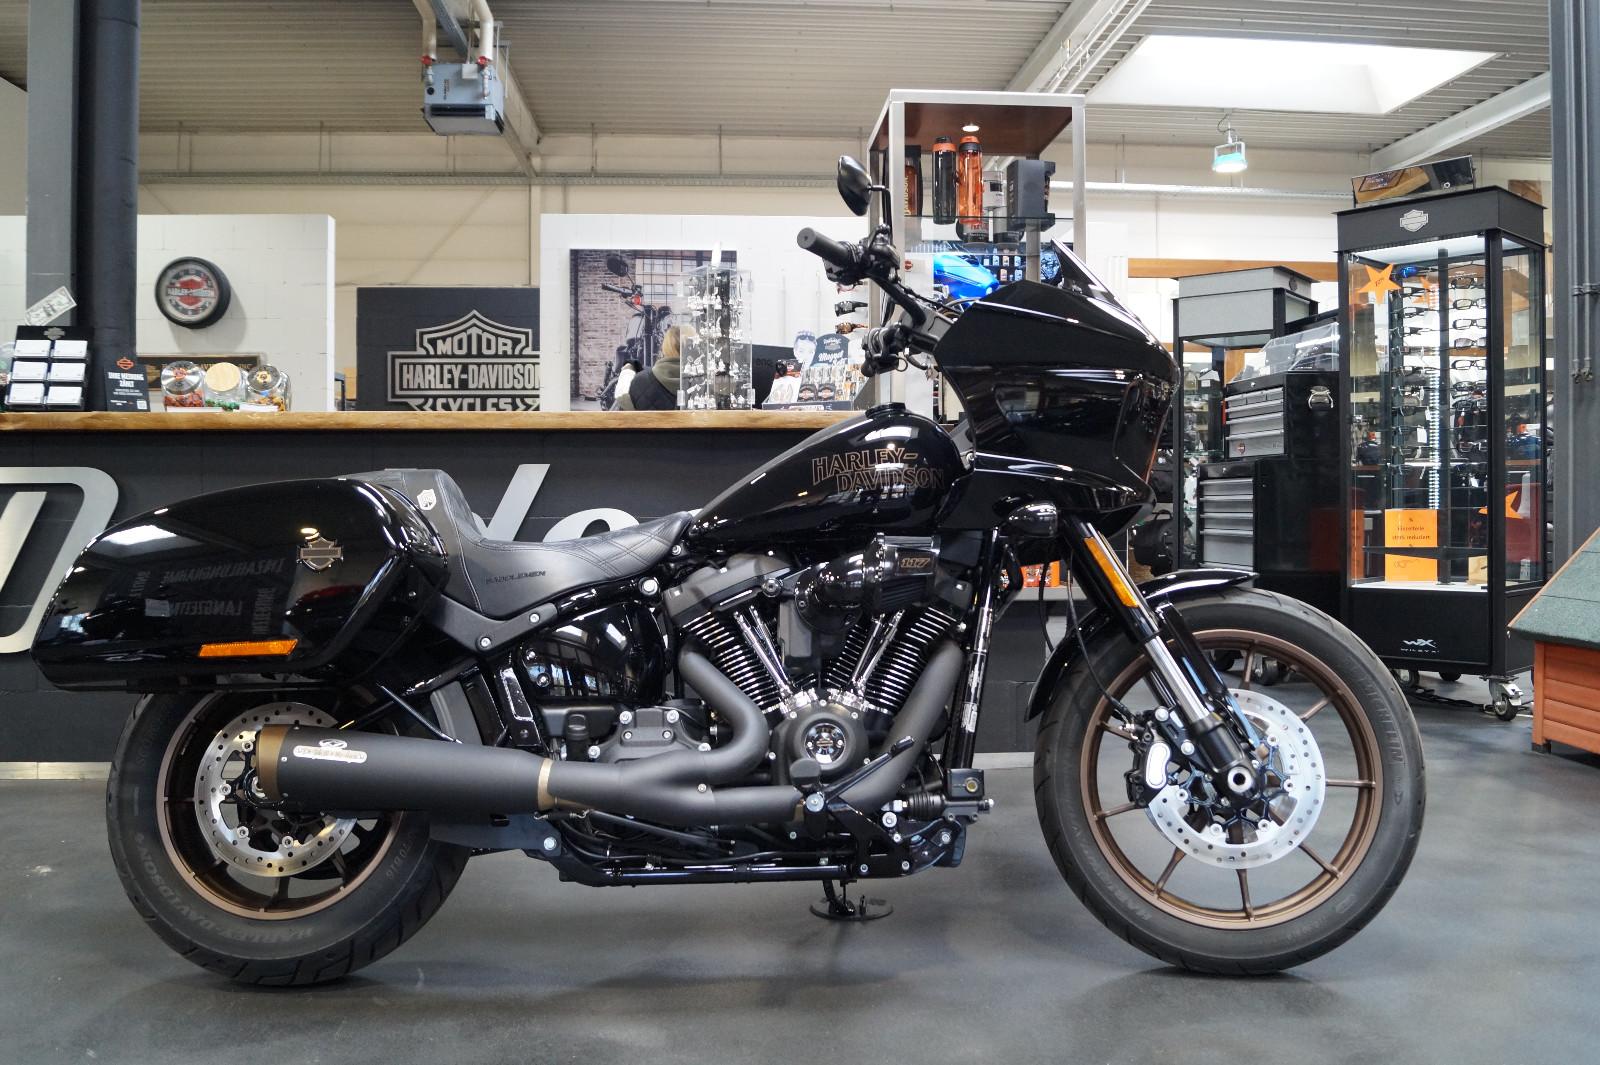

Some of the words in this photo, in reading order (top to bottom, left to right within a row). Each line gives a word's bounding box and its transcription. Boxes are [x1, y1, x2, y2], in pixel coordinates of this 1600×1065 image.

[436, 326, 513, 355] MOTOR
[836, 467, 945, 494] DAVIDSON
[900, 557, 931, 568] 117
